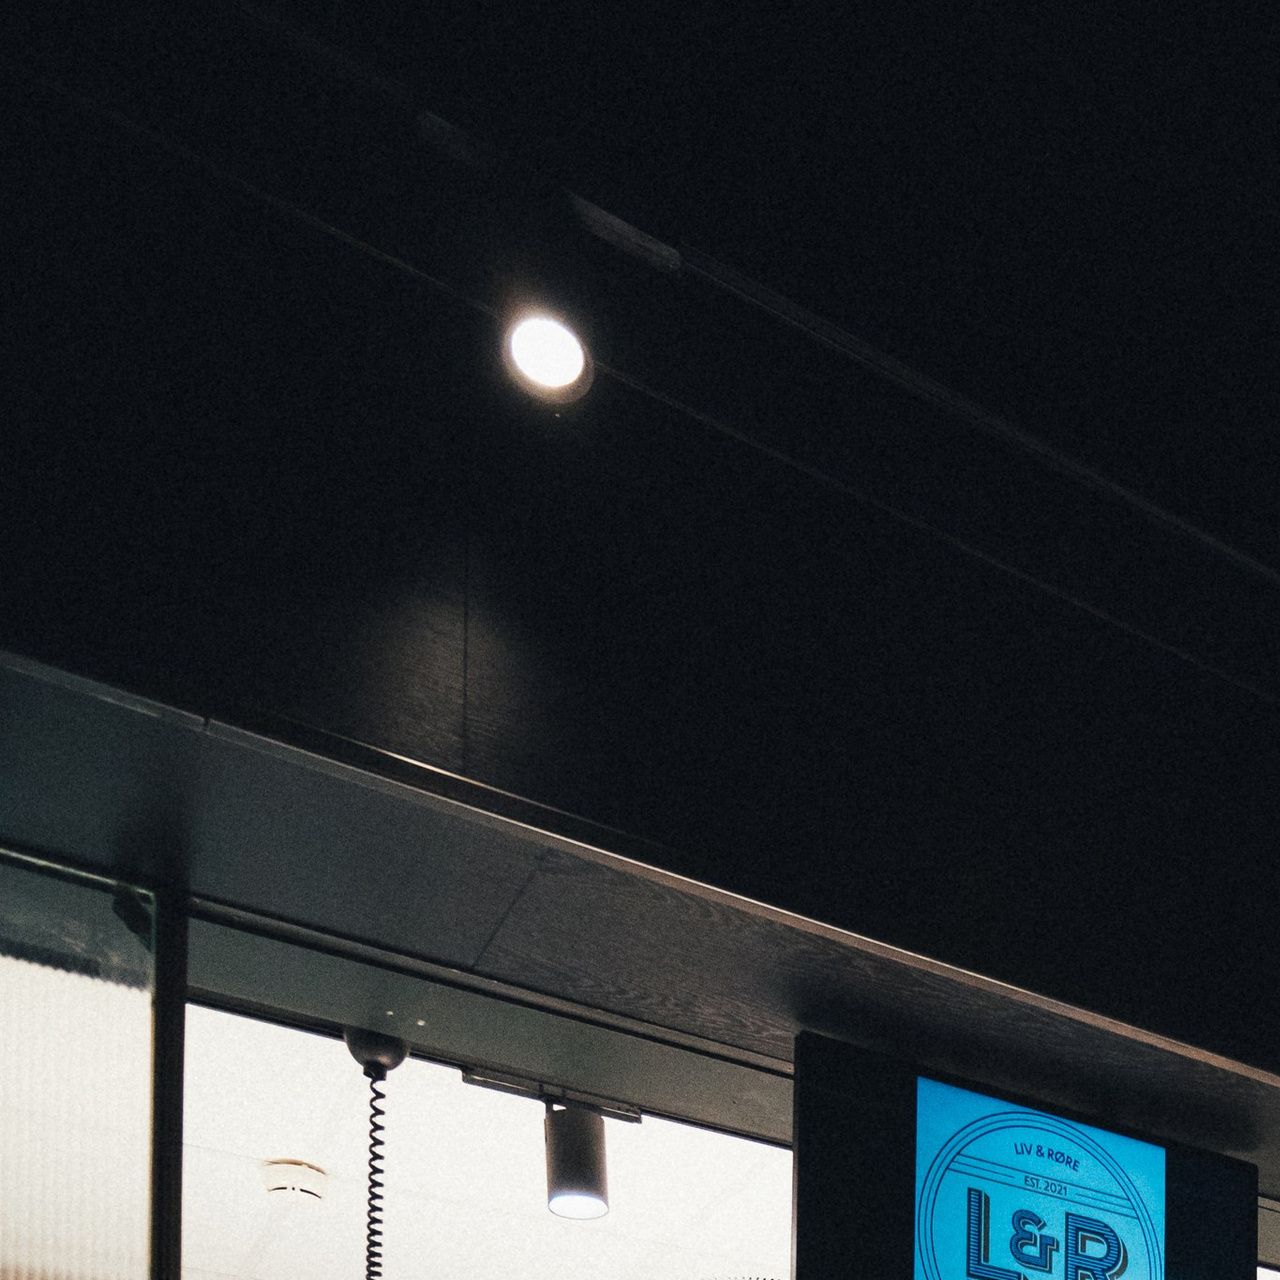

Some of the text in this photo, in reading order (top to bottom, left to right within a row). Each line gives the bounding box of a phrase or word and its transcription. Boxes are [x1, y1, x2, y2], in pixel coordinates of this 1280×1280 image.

[1014, 1142, 1080, 1172] LIV & RØRE
[1024, 1175, 1067, 1197] EST. 2021
